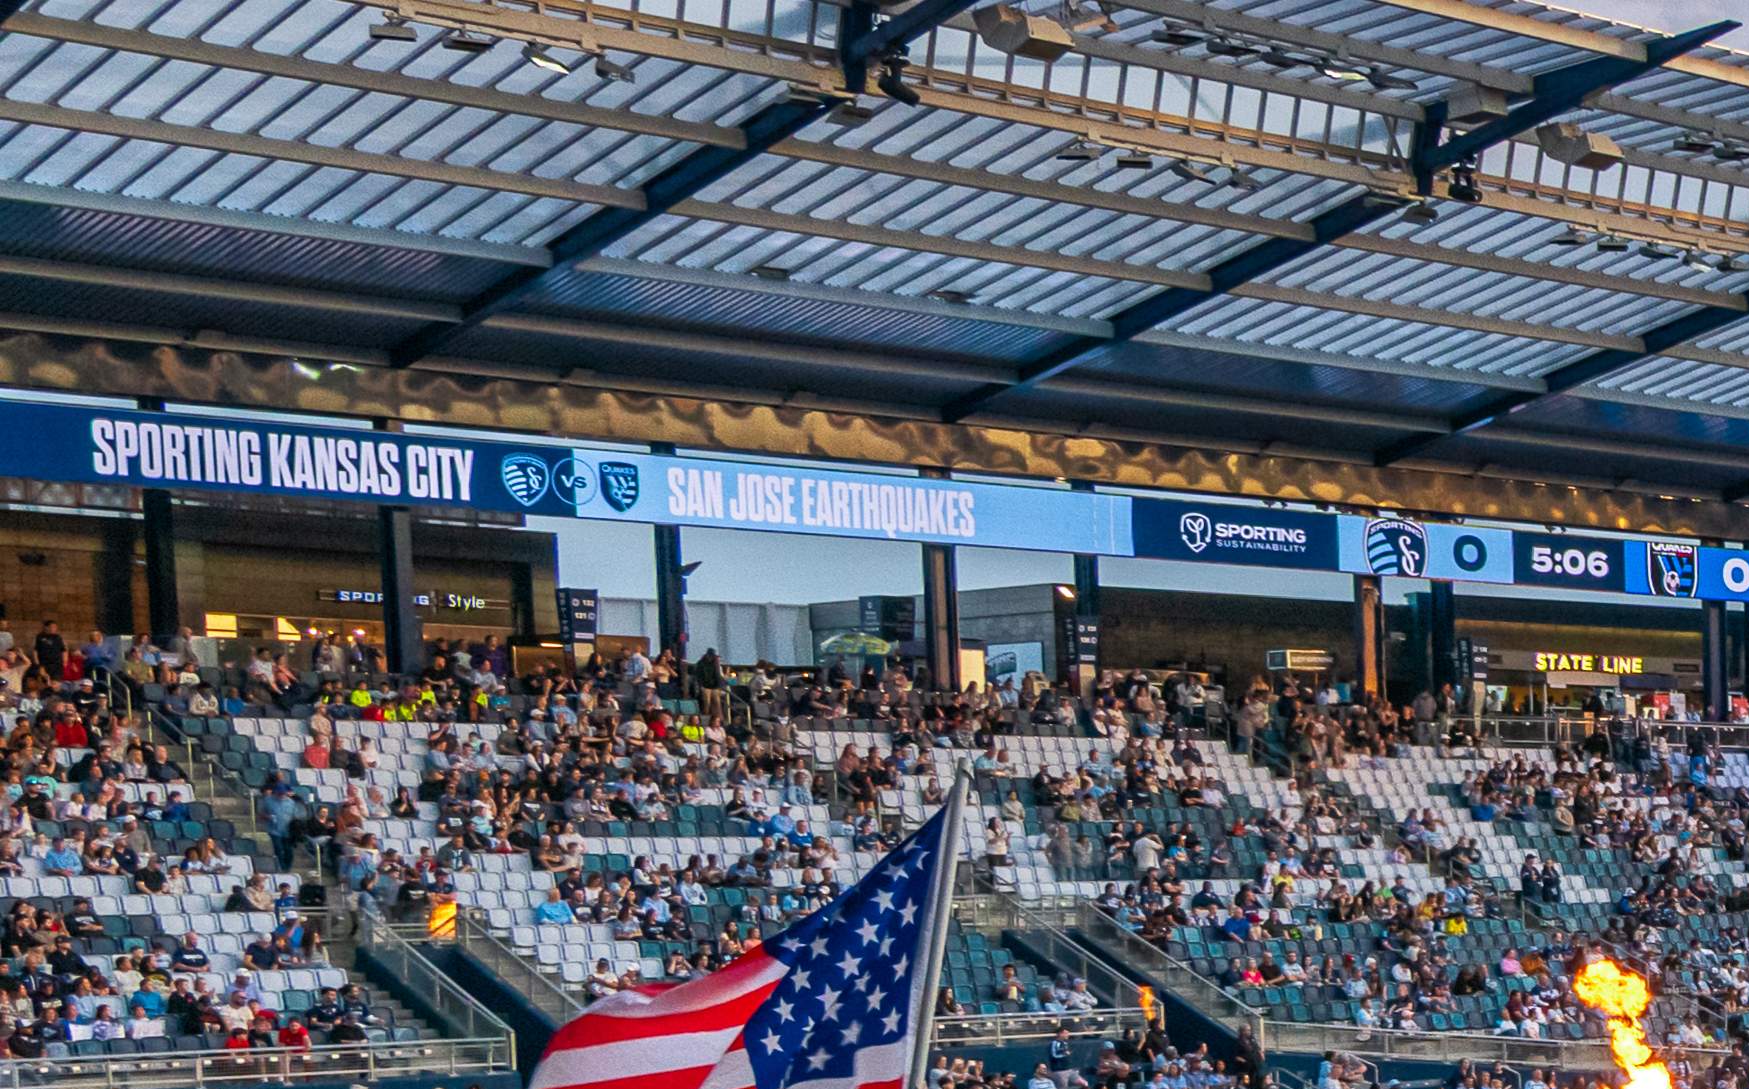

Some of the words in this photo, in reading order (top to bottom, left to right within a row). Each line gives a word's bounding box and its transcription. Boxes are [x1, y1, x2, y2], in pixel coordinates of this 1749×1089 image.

[92, 419, 261, 486] SPORTING
[270, 433, 400, 497] KANSAS
[406, 445, 473, 501] CITY
[561, 474, 587, 489] VS
[667, 467, 724, 519] SAN
[729, 472, 797, 525] JOSE
[803, 478, 975, 538] EARTHQUAKES
[1215, 522, 1306, 543] SPORTING
[1216, 538, 1306, 553] SUSTAINABILITY
[1453, 534, 1488, 572] 0
[1531, 546, 1610, 578] 5:06
[448, 594, 486, 611] Style
[1535, 651, 1593, 672] STATE
[1602, 655, 1643, 675] LINE
